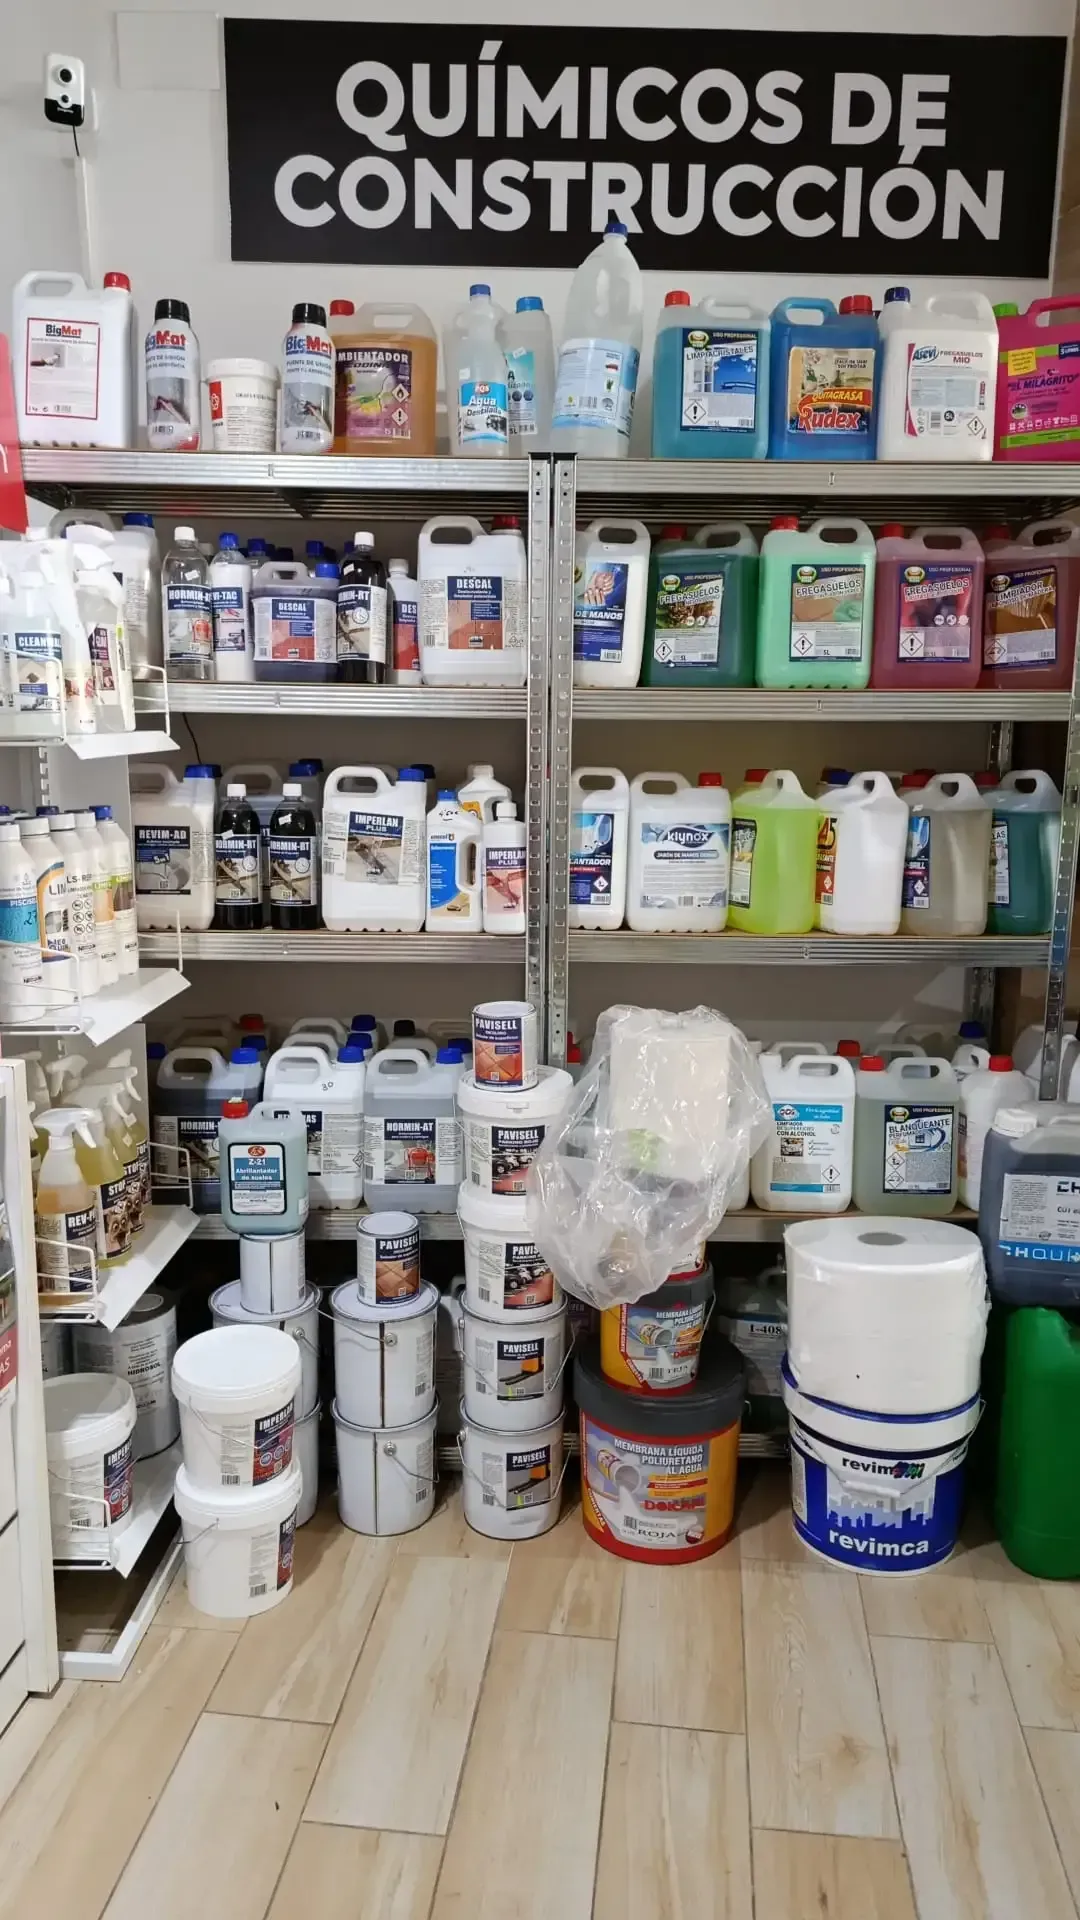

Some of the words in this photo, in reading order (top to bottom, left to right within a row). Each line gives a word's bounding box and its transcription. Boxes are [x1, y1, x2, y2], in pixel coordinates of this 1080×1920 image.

[335, 40, 804, 152] QUÍMICOS
[831, 71, 951, 149] DE
[274, 143, 1005, 241] CONSTRUCCIÓN
[45, 323, 82, 338] BigMat
[336, 350, 409, 364] MBIENTADOR
[686, 345, 754, 361] LIMPIACRISTALES
[912, 345, 937, 361] Asevi
[468, 395, 497, 408] Agua
[812, 389, 864, 402] QUITAGRASA
[797, 405, 862, 432] Rudex
[456, 578, 493, 590] DESCAL
[795, 579, 862, 597] FREGASUELOS
[904, 578, 970, 596] FREGASUELOS
[995, 580, 1044, 602] LIMPIADOR
[659, 585, 720, 605] FREGASUELOS
[278, 602, 307, 612] DESCAL
[588, 611, 624, 620] MANOS
[355, 814, 399, 828] IMPERLAN
[138, 829, 187, 840] REVIM-AD
[667, 830, 709, 846] klynox
[475, 1017, 518, 1031] PAVISELL
[180, 1121, 219, 1131] HORMIN-
[386, 1122, 434, 1133] HORMIN-AT
[888, 1118, 951, 1134] BLANQUEANTE
[498, 1129, 539, 1140] PAVISELL
[248, 1158, 266, 1166] Z-21
[235, 1167, 278, 1175] Abrillantador
[503, 1342, 539, 1353] PAVISELL
[614, 1438, 666, 1457] MEMBRANA
[668, 1444, 704, 1457] LÍQUIDA
[512, 1450, 547, 1464] PAVISELL
[641, 1454, 703, 1466] POLIURETANO
[665, 1464, 678, 1475] AL
[679, 1463, 703, 1475] AGUA
[638, 1529, 677, 1539] ROJA
[828, 1529, 929, 1557] revimca
